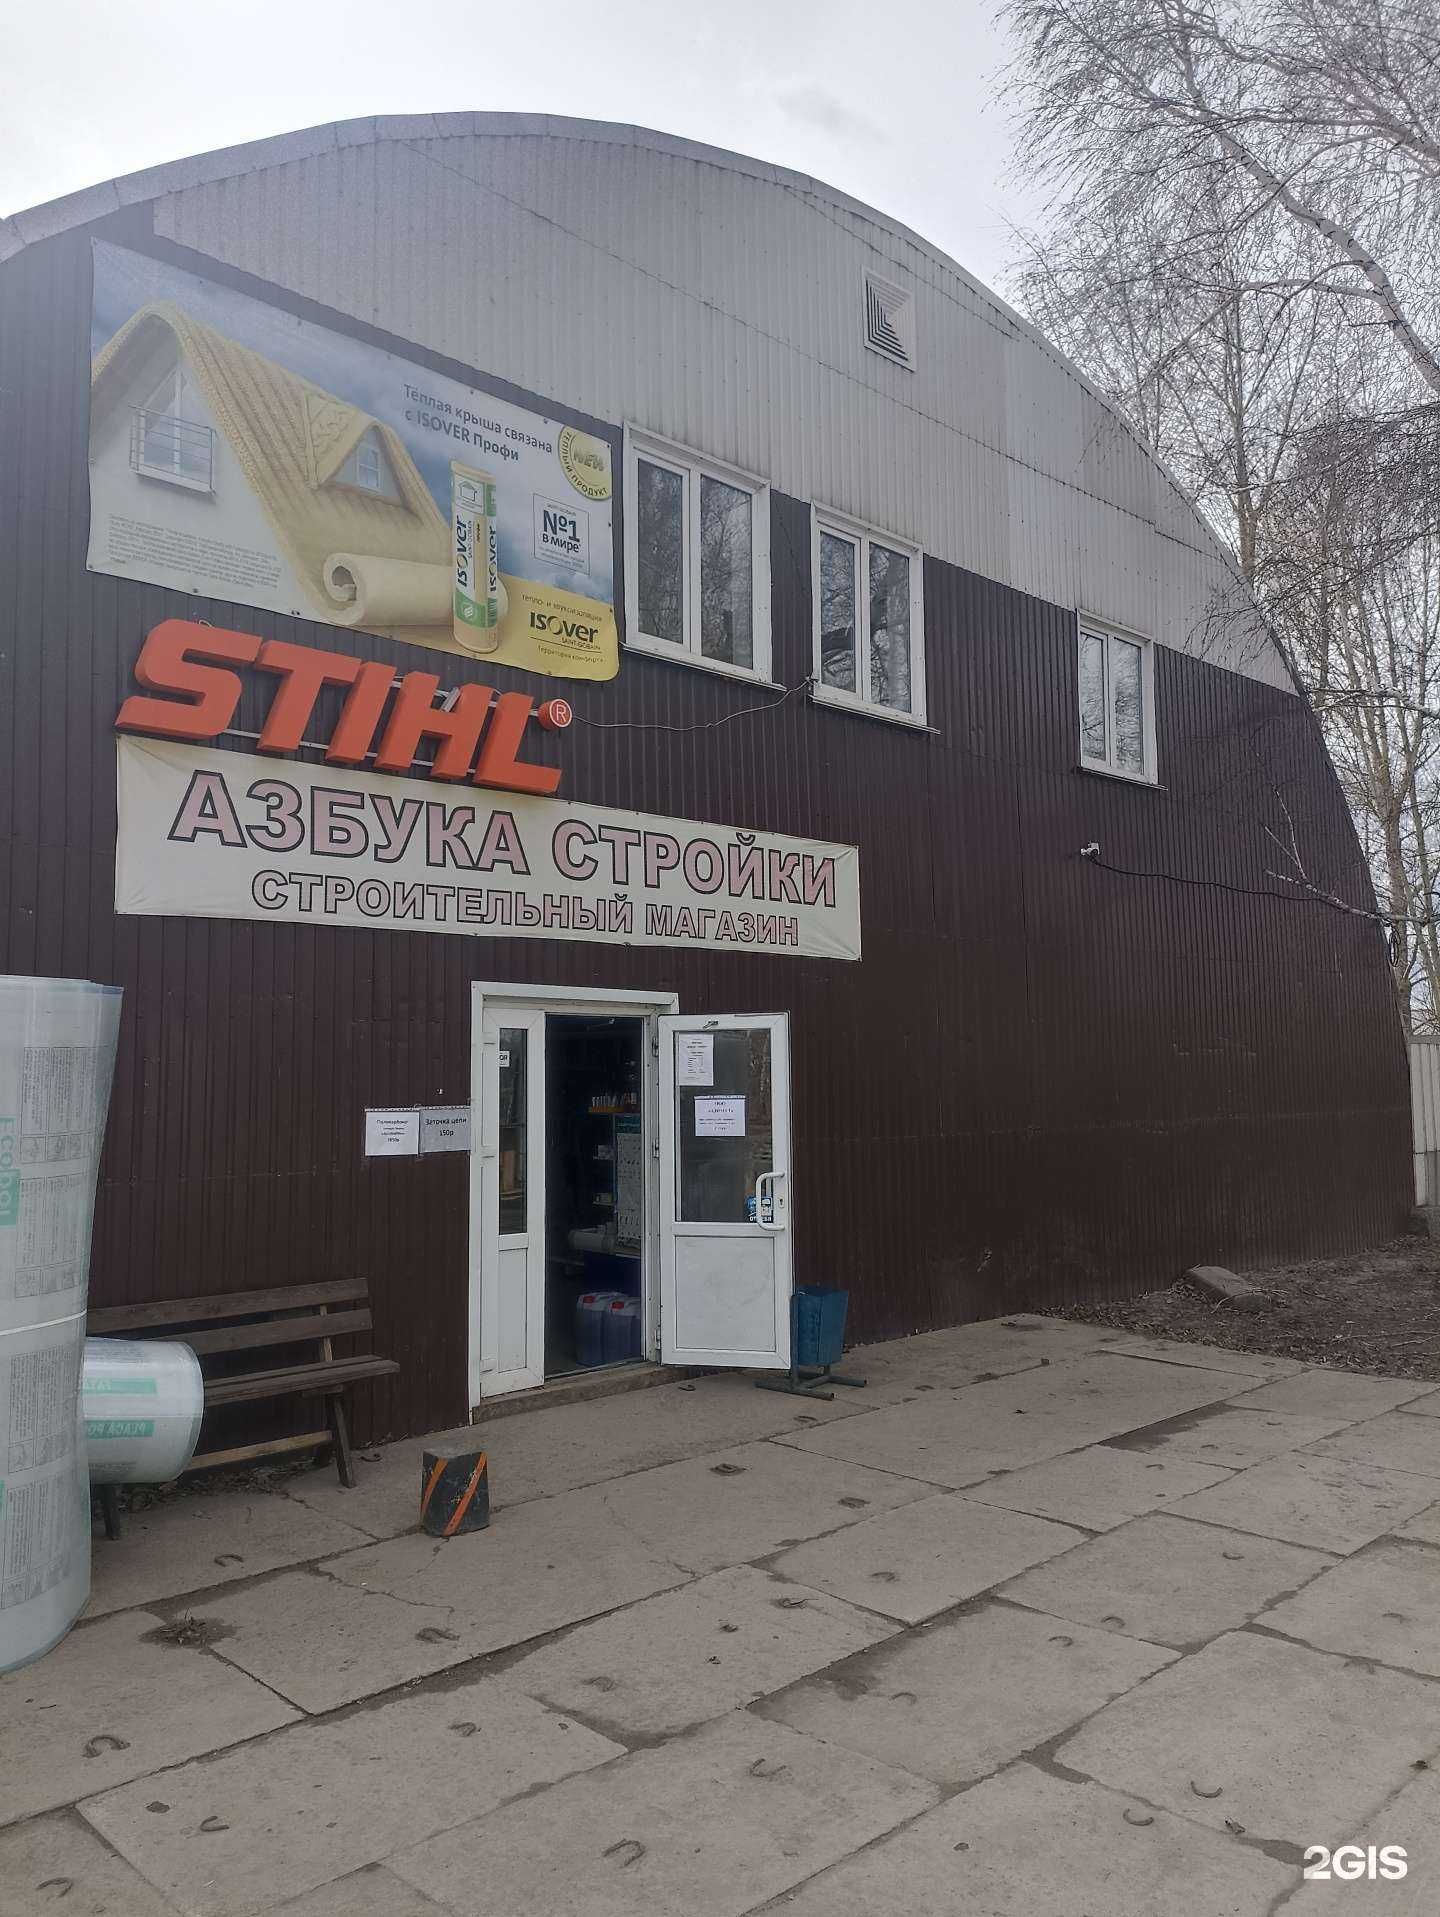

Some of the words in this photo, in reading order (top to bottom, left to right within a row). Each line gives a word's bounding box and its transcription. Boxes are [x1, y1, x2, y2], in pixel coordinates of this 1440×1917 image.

[405, 410, 412, 421] с
[417, 411, 470, 444] ISOVER
[473, 432, 519, 460] Профи
[455, 405, 502, 434] крыша
[504, 426, 553, 454] связана
[115, 619, 562, 795] STIHL
[167, 769, 532, 877] АЗБУКА
[551, 831, 837, 908] СТРОЙКИ
[251, 869, 634, 935] СТРОИТЕЛЬНЫЙ
[644, 902, 800, 947] МАГАЗИН
